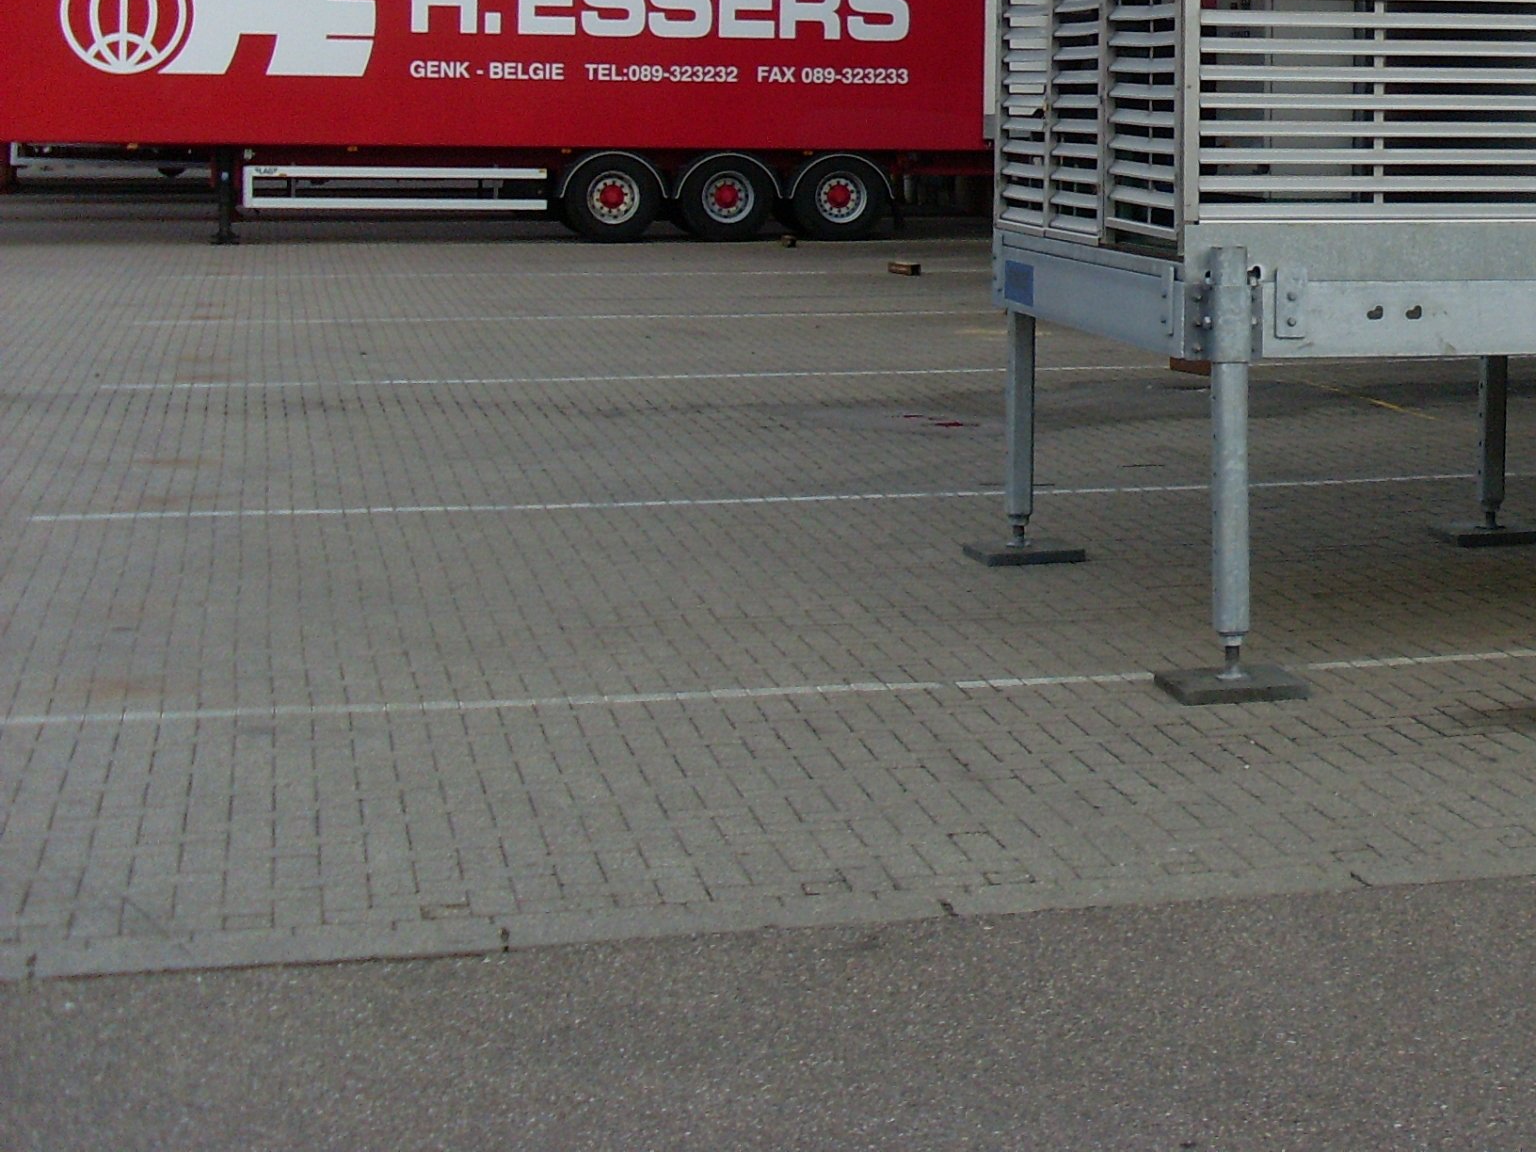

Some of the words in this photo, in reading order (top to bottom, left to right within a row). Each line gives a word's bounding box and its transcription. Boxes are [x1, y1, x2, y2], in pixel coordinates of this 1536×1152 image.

[410, 60, 470, 79] GENK
[489, 62, 565, 81] BELGIE
[585, 64, 738, 83] TEL:089-323232
[757, 66, 796, 84] FAX
[801, 67, 909, 85] 089-323233
